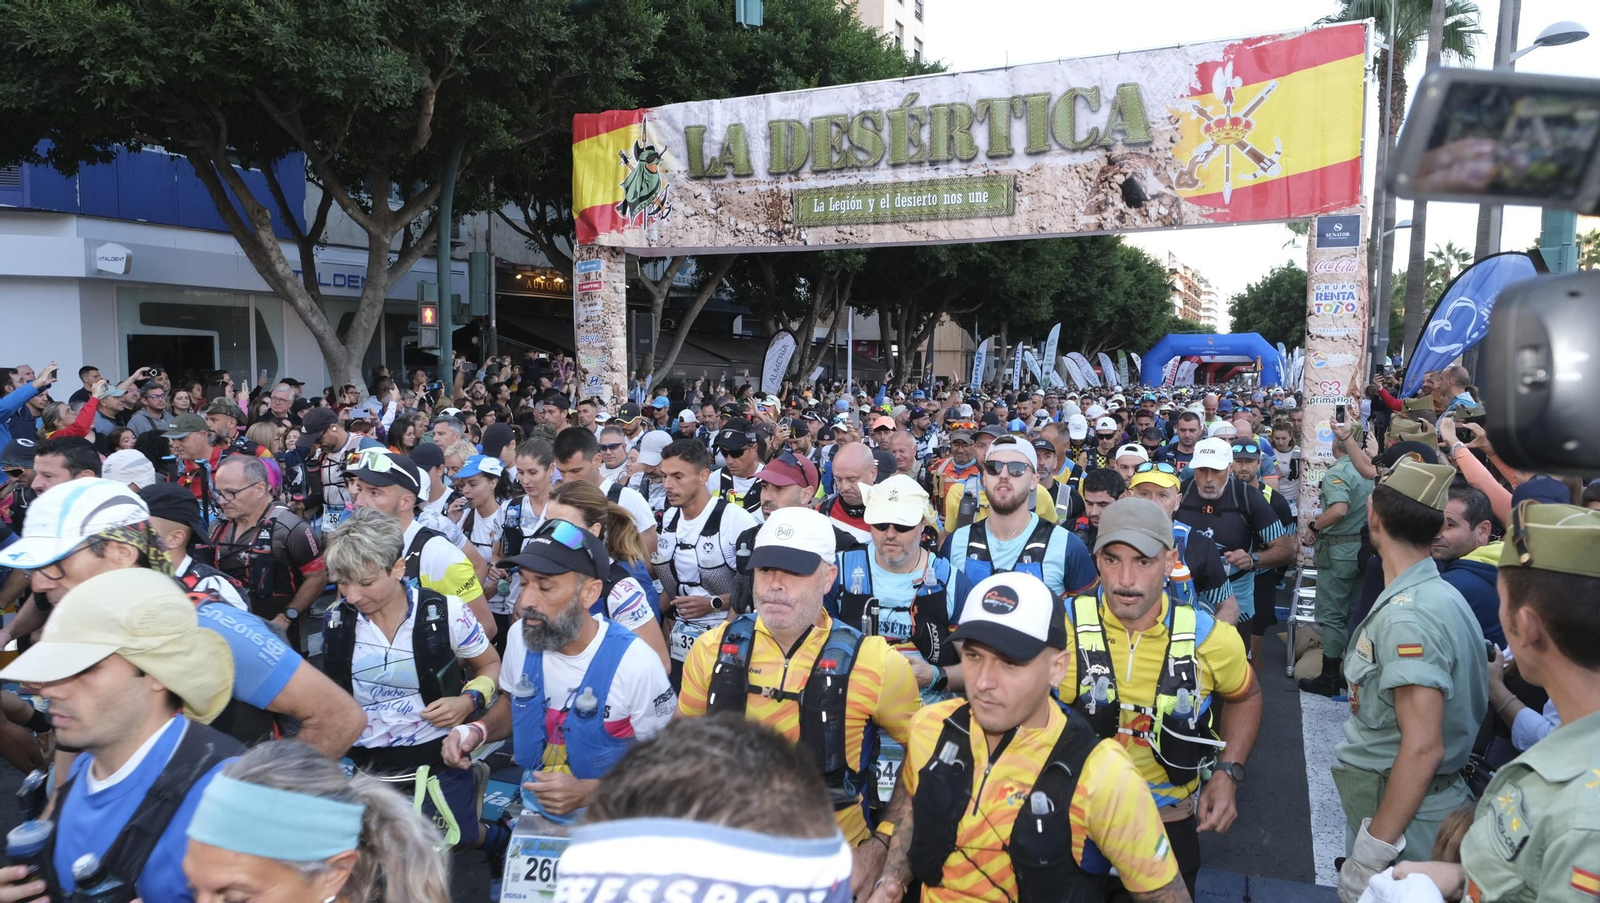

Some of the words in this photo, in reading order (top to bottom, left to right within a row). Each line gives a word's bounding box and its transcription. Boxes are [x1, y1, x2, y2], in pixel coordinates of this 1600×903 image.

[684, 122, 754, 179] LA
[767, 82, 1154, 175] DESÉRTICA
[813, 198, 826, 213] La
[829, 193, 863, 213] Legión
[868, 199, 875, 213] y
[880, 194, 890, 209] el
[894, 192, 938, 208] desierto
[943, 194, 963, 206] nos
[968, 191, 989, 204] une
[1315, 292, 1356, 301] RENTA
[1315, 303, 1356, 314] TODO
[580, 334, 601, 343] BBVA
[1310, 396, 1353, 405] primaflor
[777, 527, 792, 537] Buff
